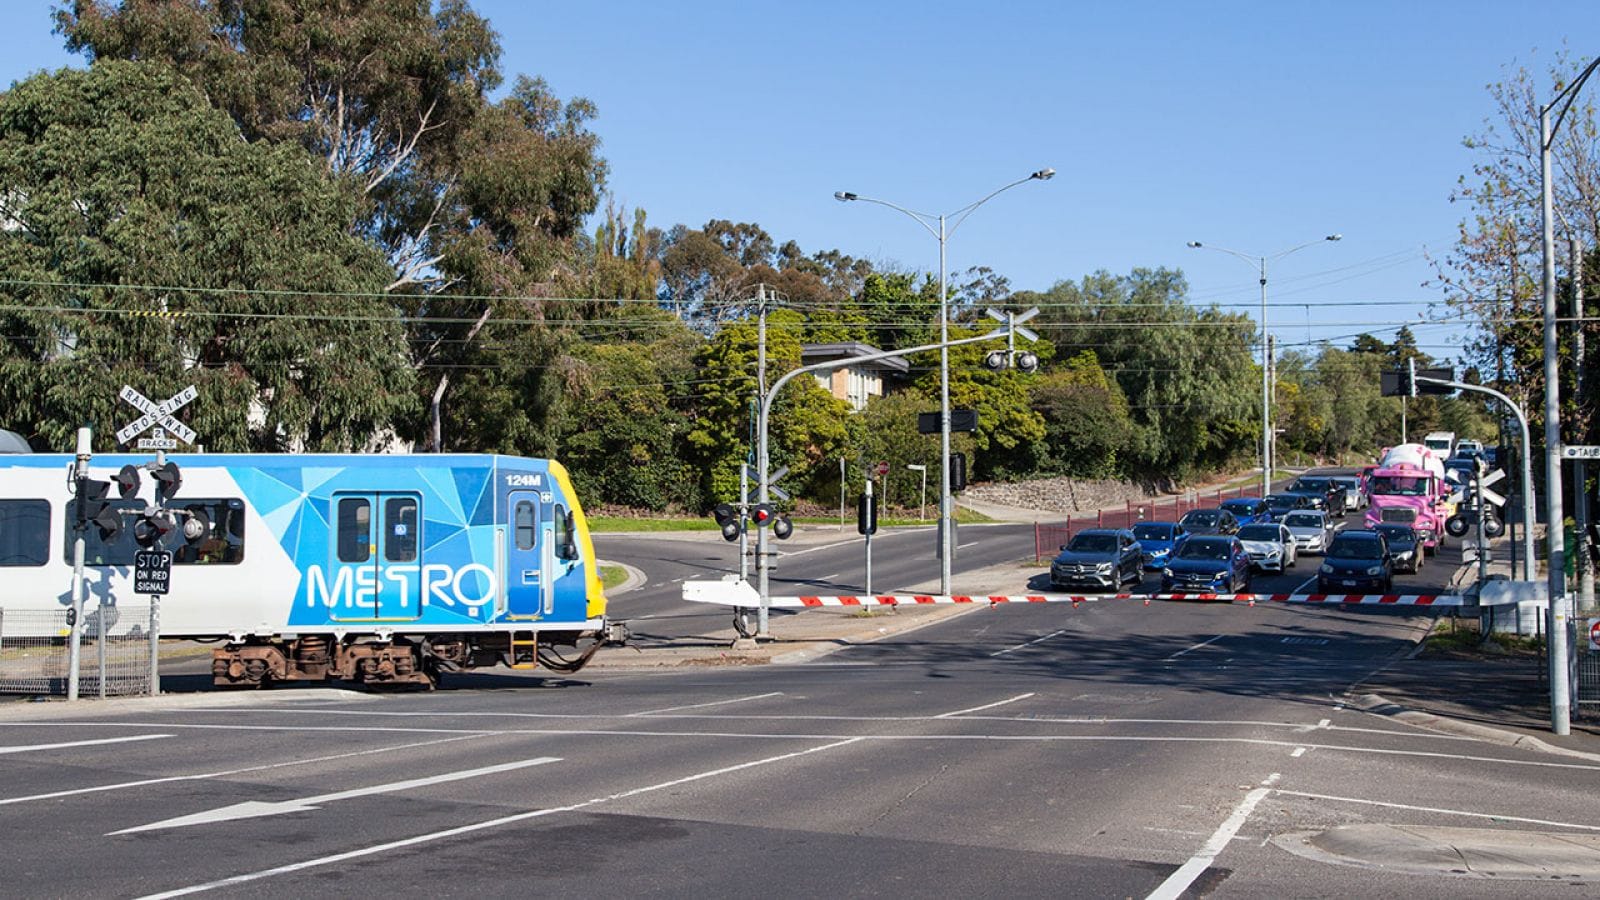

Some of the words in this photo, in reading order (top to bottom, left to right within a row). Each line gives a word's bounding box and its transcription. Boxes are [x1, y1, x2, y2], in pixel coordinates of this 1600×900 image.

[122, 389, 193, 439] CROSSING
[154, 429, 161, 438] 2
[140, 439, 175, 447] TRACKS
[505, 474, 541, 486] 124M
[138, 554, 169, 567] STOP
[136, 570, 148, 580] ON
[152, 570, 168, 580] RED
[137, 582, 166, 592] SIGNAL
[307, 563, 497, 607] METRO
